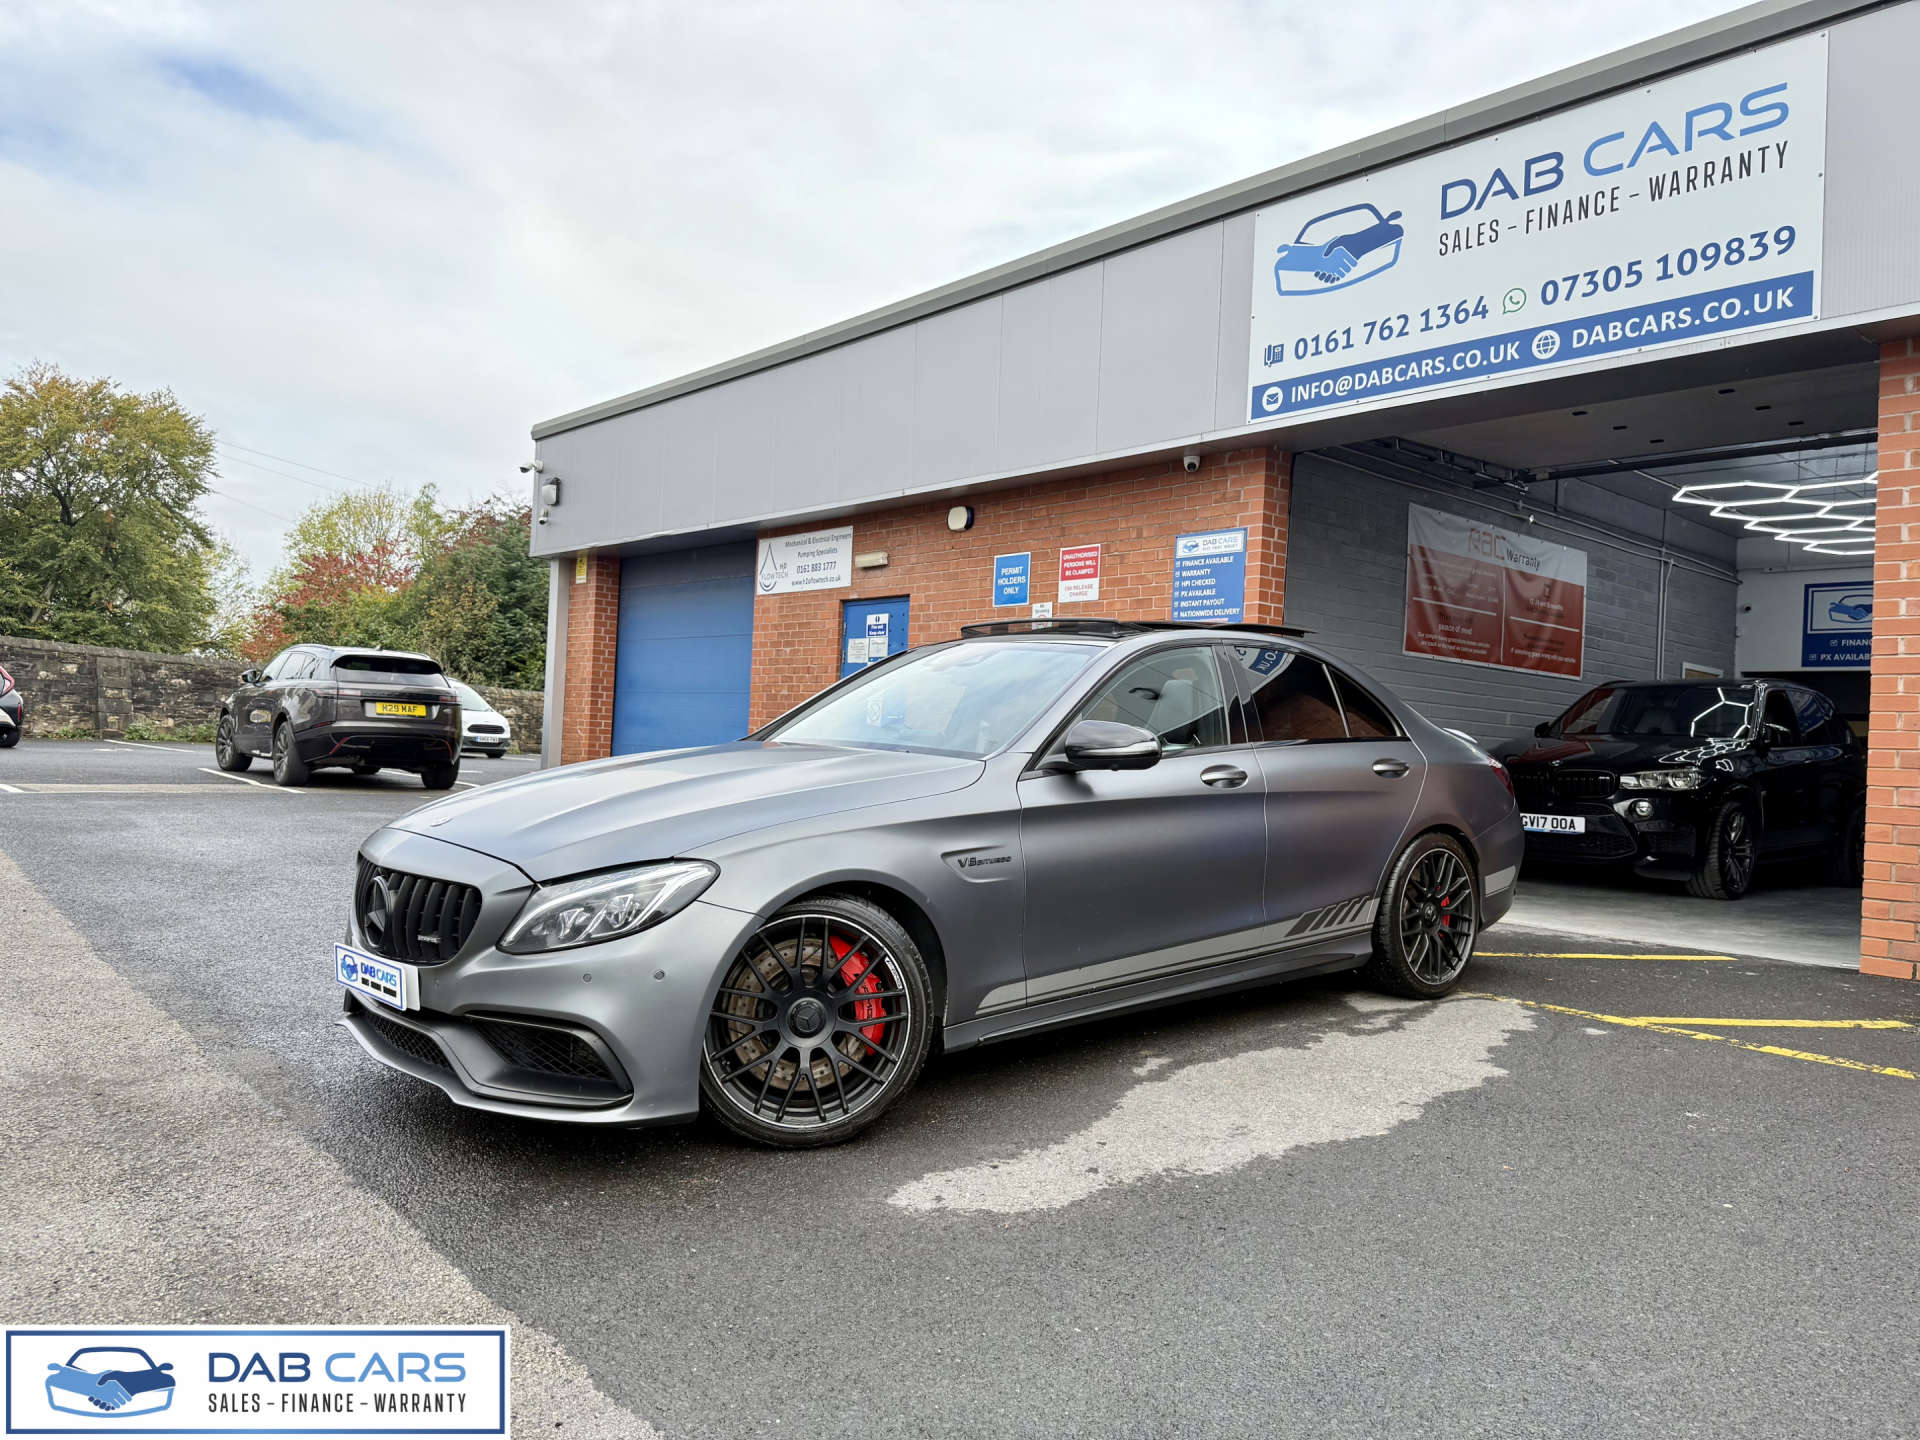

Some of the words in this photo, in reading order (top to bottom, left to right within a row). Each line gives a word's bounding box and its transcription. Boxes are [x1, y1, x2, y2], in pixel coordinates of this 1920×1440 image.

[1441, 151, 1564, 220] DAB
[1583, 82, 1789, 177] CARS
[1439, 219, 1499, 256] SALES
[1526, 186, 1620, 234] FINANCE
[1649, 140, 1788, 202] WARRANTY
[1541, 259, 1643, 306] 07305
[1656, 225, 1796, 281] 109839
[1571, 286, 1795, 349] DABCARS.CO.UK
[1294, 326, 1354, 360] 0161
[1363, 313, 1410, 345] 762
[1419, 295, 1489, 333] 1364
[1291, 340, 1521, 404] INFO@DABCARS.CO.UK
[1182, 558, 1205, 567] FINANCE
[1205, 556, 1234, 565] AVAILABLE
[1506, 549, 1541, 571] Warranty
[1001, 566, 1024, 576] PERMIT
[1181, 568, 1211, 577] WARRANTY
[998, 575, 1026, 586] HOLDERS
[1191, 578, 1216, 587] CHECKED
[1003, 586, 1019, 595] ONLY
[1188, 588, 1216, 597] AVAILABLE
[1180, 600, 1202, 608] INSTANT
[1203, 598, 1225, 607] PAYOUT
[1180, 609, 1213, 618] NATIONWIDE
[1214, 607, 1240, 617] DELIVERY
[1841, 639, 1872, 647] FINANC
[1820, 653, 1832, 661] PX
[1833, 653, 1871, 661] AVAILAB
[1520, 815, 1548, 829] GV17
[957, 856, 976, 868] V8
[360, 961, 376, 979] DAB
[376, 967, 397, 988] CARS
